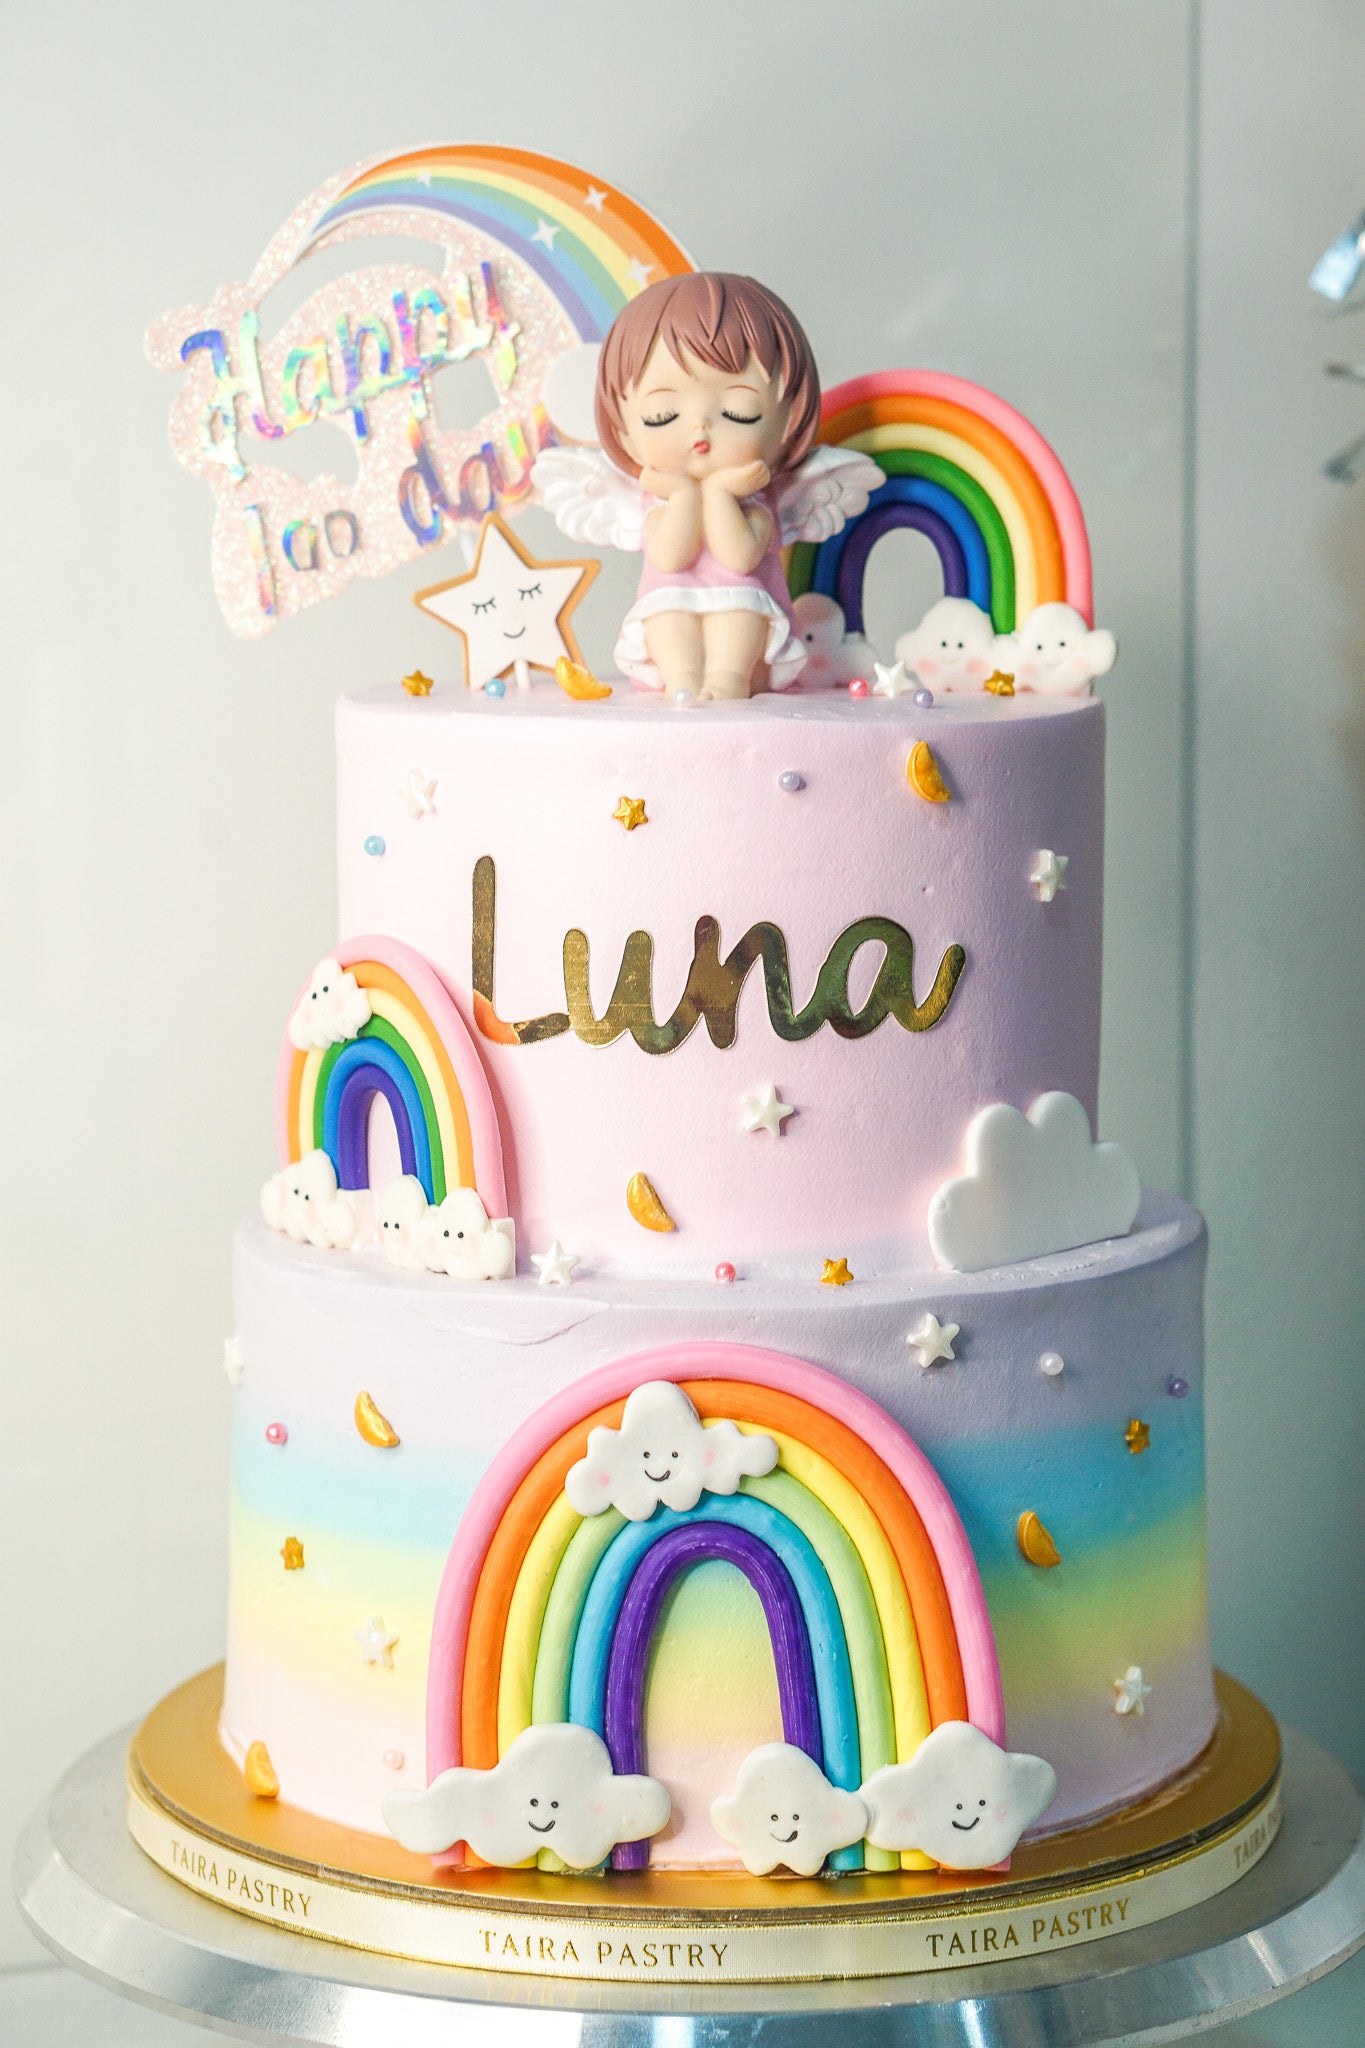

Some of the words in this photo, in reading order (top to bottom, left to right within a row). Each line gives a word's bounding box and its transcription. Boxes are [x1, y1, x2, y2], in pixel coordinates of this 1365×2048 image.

[180, 261, 522, 483] Happy
[472, 855, 967, 1056] Luna
[171, 1840, 219, 1885] TAIRA
[227, 1869, 313, 1917] PASTRY
[479, 1930, 579, 1962] TAIRA
[597, 1941, 728, 1968] PASTRY
[926, 1926, 1019, 1958] TAIRA
[1032, 1897, 1130, 1943] PASTRY
